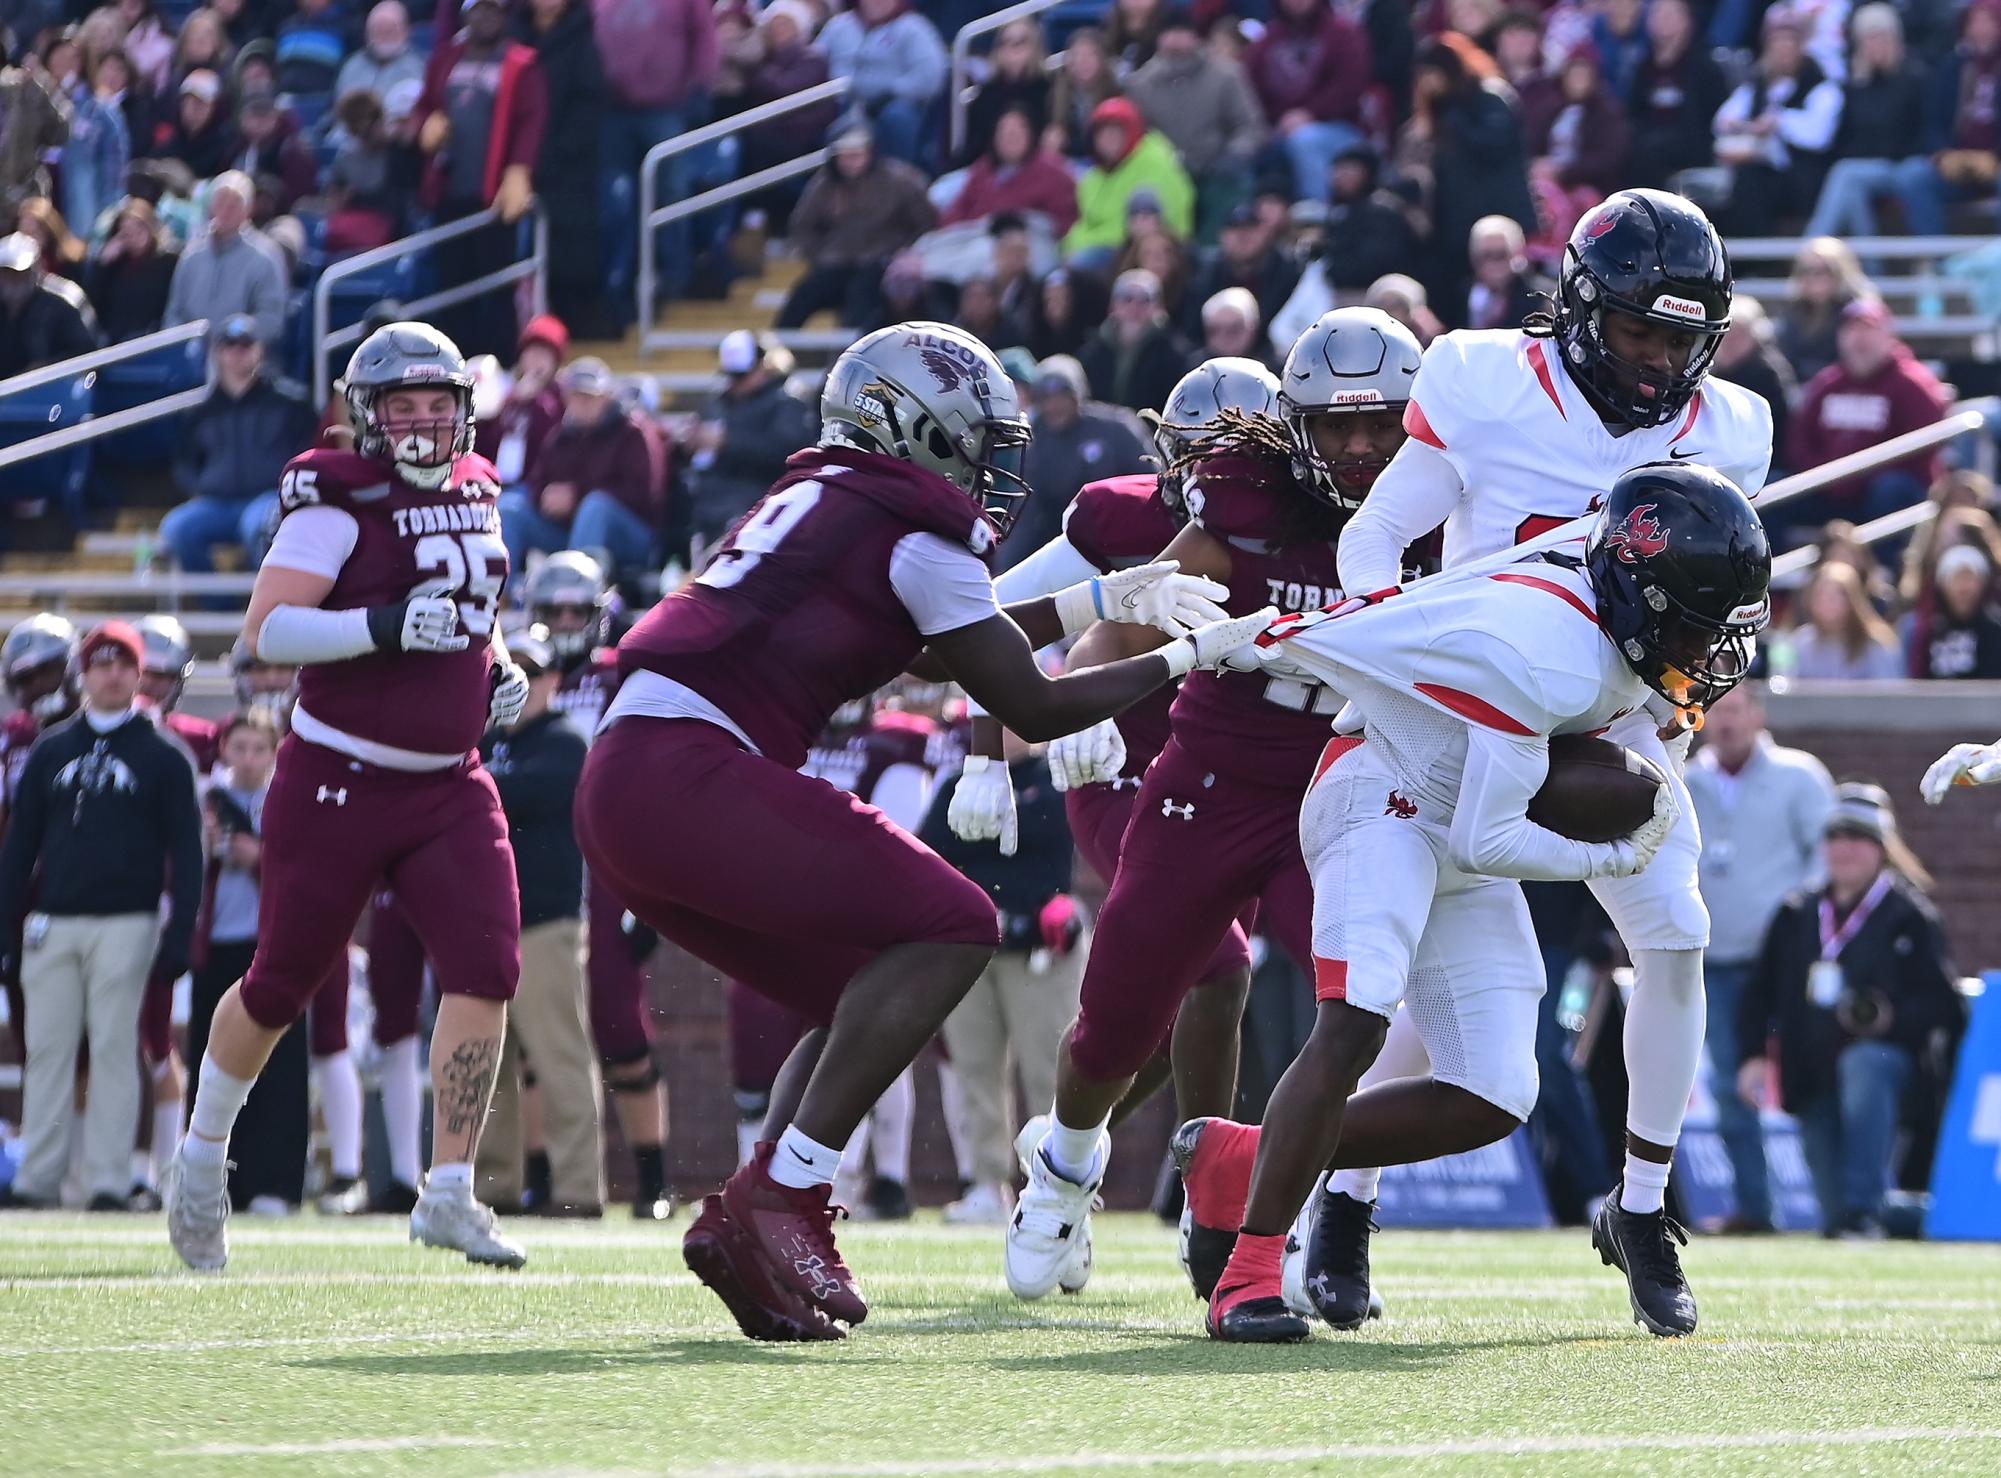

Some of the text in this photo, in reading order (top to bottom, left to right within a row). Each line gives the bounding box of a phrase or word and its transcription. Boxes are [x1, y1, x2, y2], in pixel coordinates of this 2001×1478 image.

[1662, 299, 1702, 316] Riddell
[902, 333, 989, 378] ALCOA
[1682, 348, 1711, 380] Riddell
[1336, 392, 1377, 403] Riddell
[406, 533, 509, 635] 25
